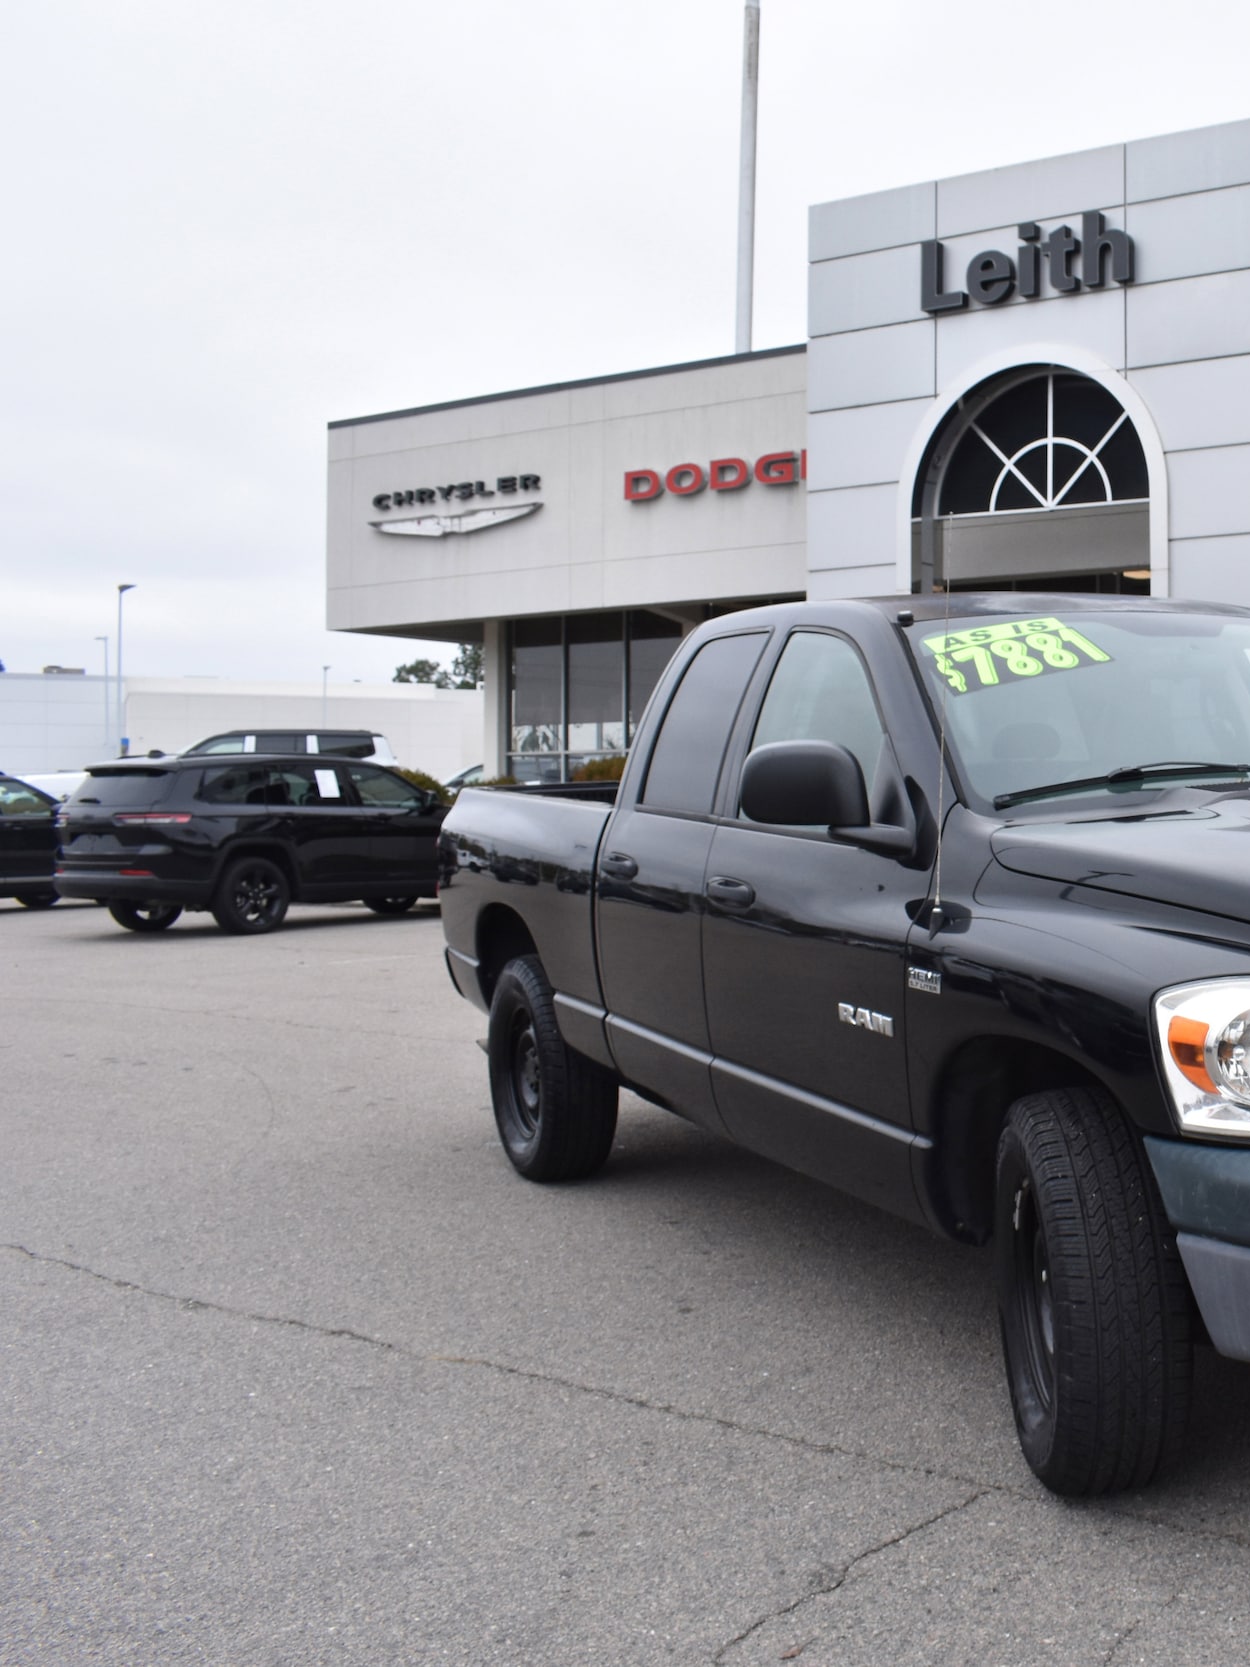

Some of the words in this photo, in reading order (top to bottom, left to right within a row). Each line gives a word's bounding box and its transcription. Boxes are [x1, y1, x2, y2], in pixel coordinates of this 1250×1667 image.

[920, 211, 1135, 313] Leith
[372, 474, 541, 510] CHRYSLER
[624, 449, 807, 502] DODG
[944, 629, 992, 649] AS
[1013, 620, 1049, 634] IS
[934, 627, 1112, 692] $7881
[838, 1002, 895, 1037] RAM
